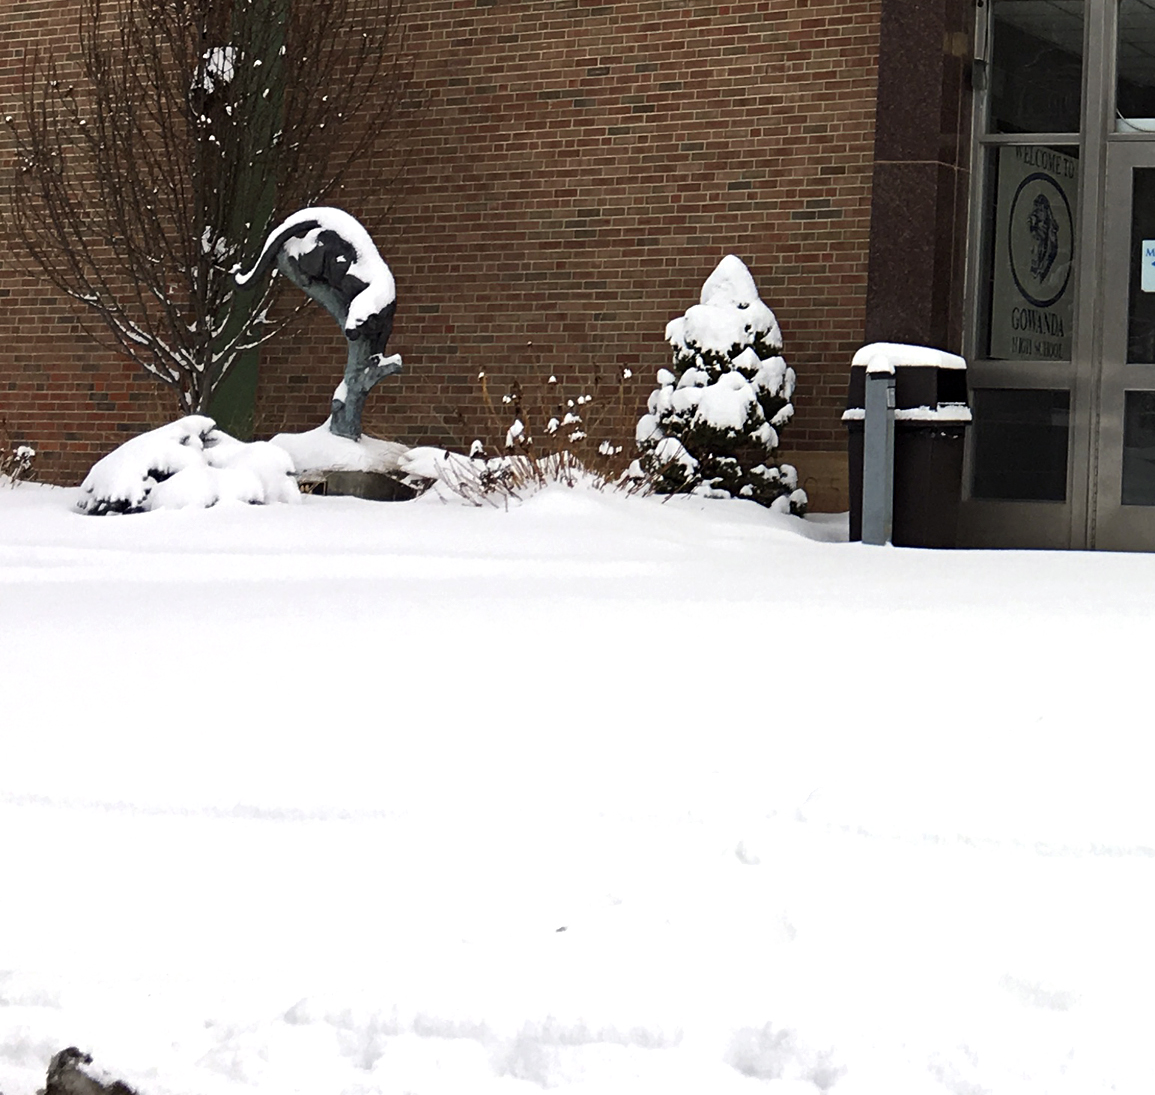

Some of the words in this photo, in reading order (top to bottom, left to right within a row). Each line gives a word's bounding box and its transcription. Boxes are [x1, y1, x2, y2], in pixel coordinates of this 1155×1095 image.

[1015, 145, 1062, 175] WELCOME
[1063, 158, 1075, 179] TO
[1011, 306, 1065, 338] GOWANDA
[1034, 341, 1064, 359] SCHOOL
